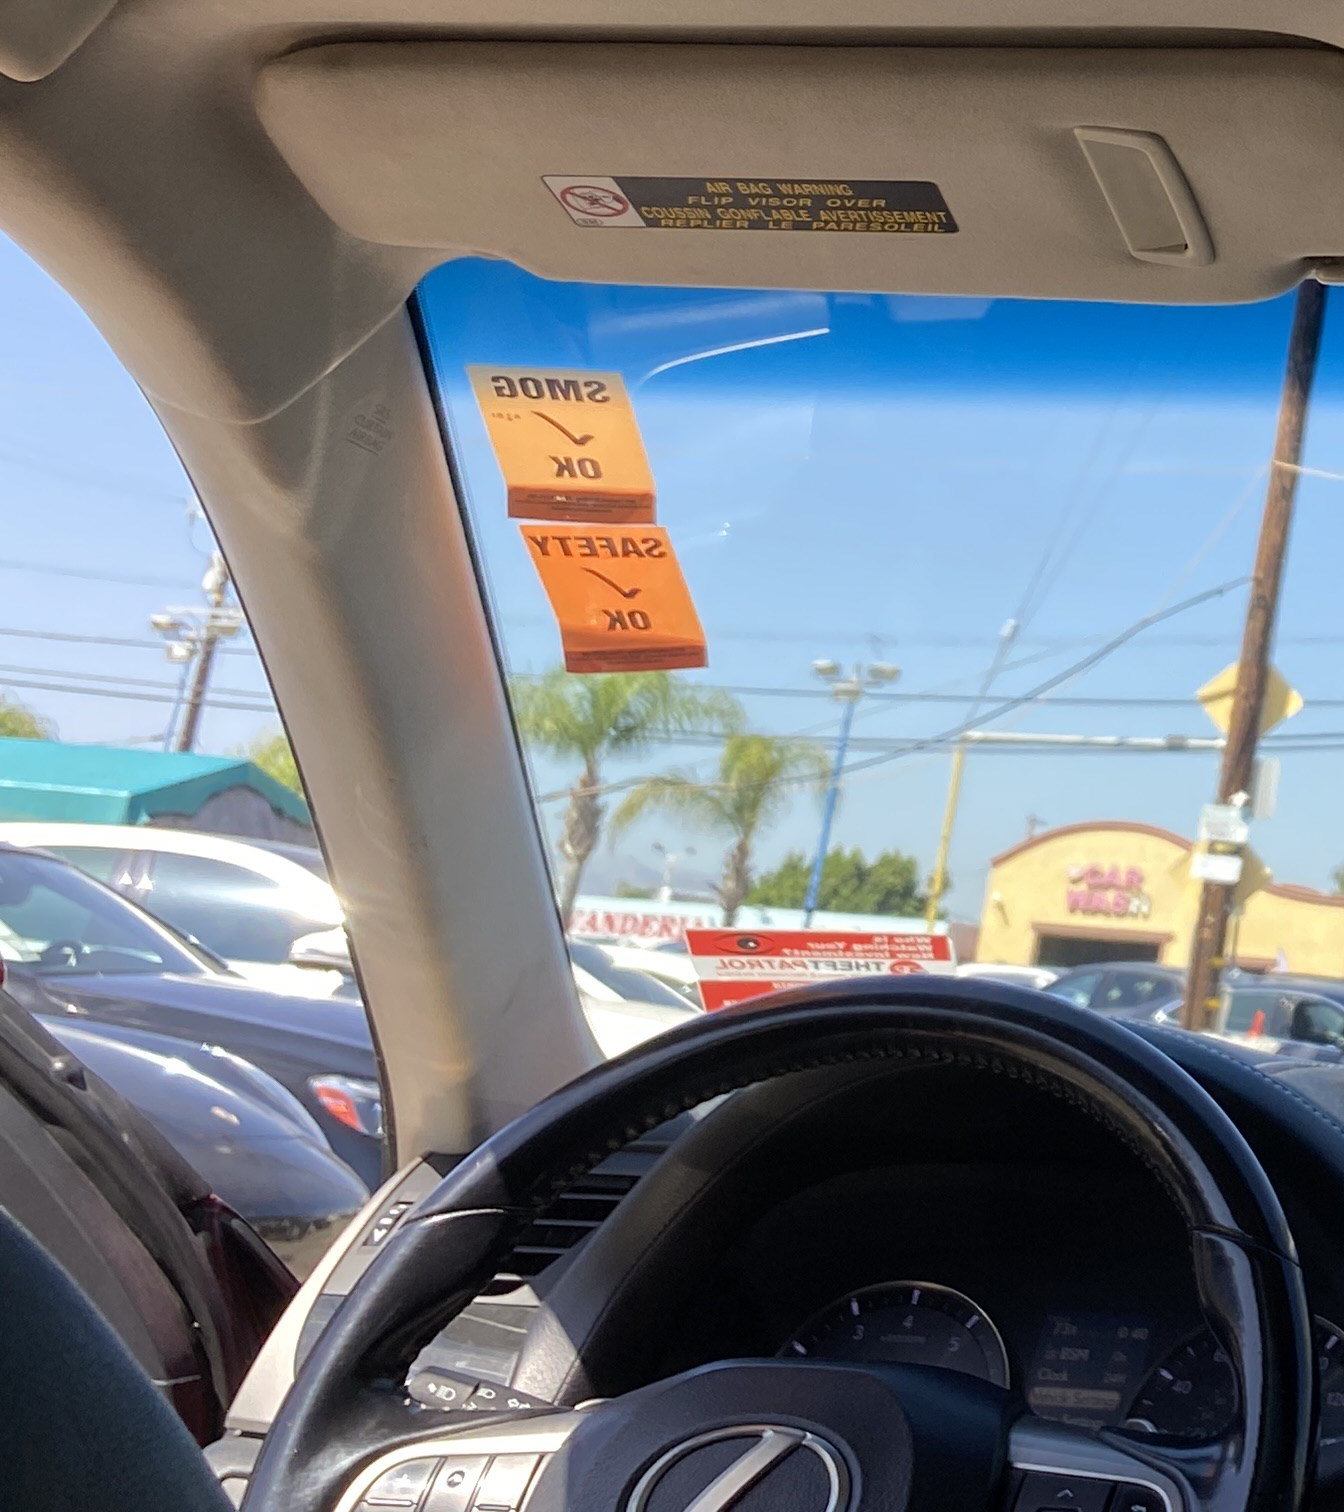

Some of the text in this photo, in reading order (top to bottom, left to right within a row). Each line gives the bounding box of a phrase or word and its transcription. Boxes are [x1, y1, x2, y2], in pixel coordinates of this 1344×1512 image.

[705, 182, 854, 197] AIR BAG WARNING
[688, 195, 887, 209] FLIP VISOR OVER
[640, 206, 947, 224] COUSSIN GONFLABLE AVERTISSEMENT
[660, 218, 945, 233] REPLIER LE PARESOLEIL
[853, 1324, 864, 1341] 3
